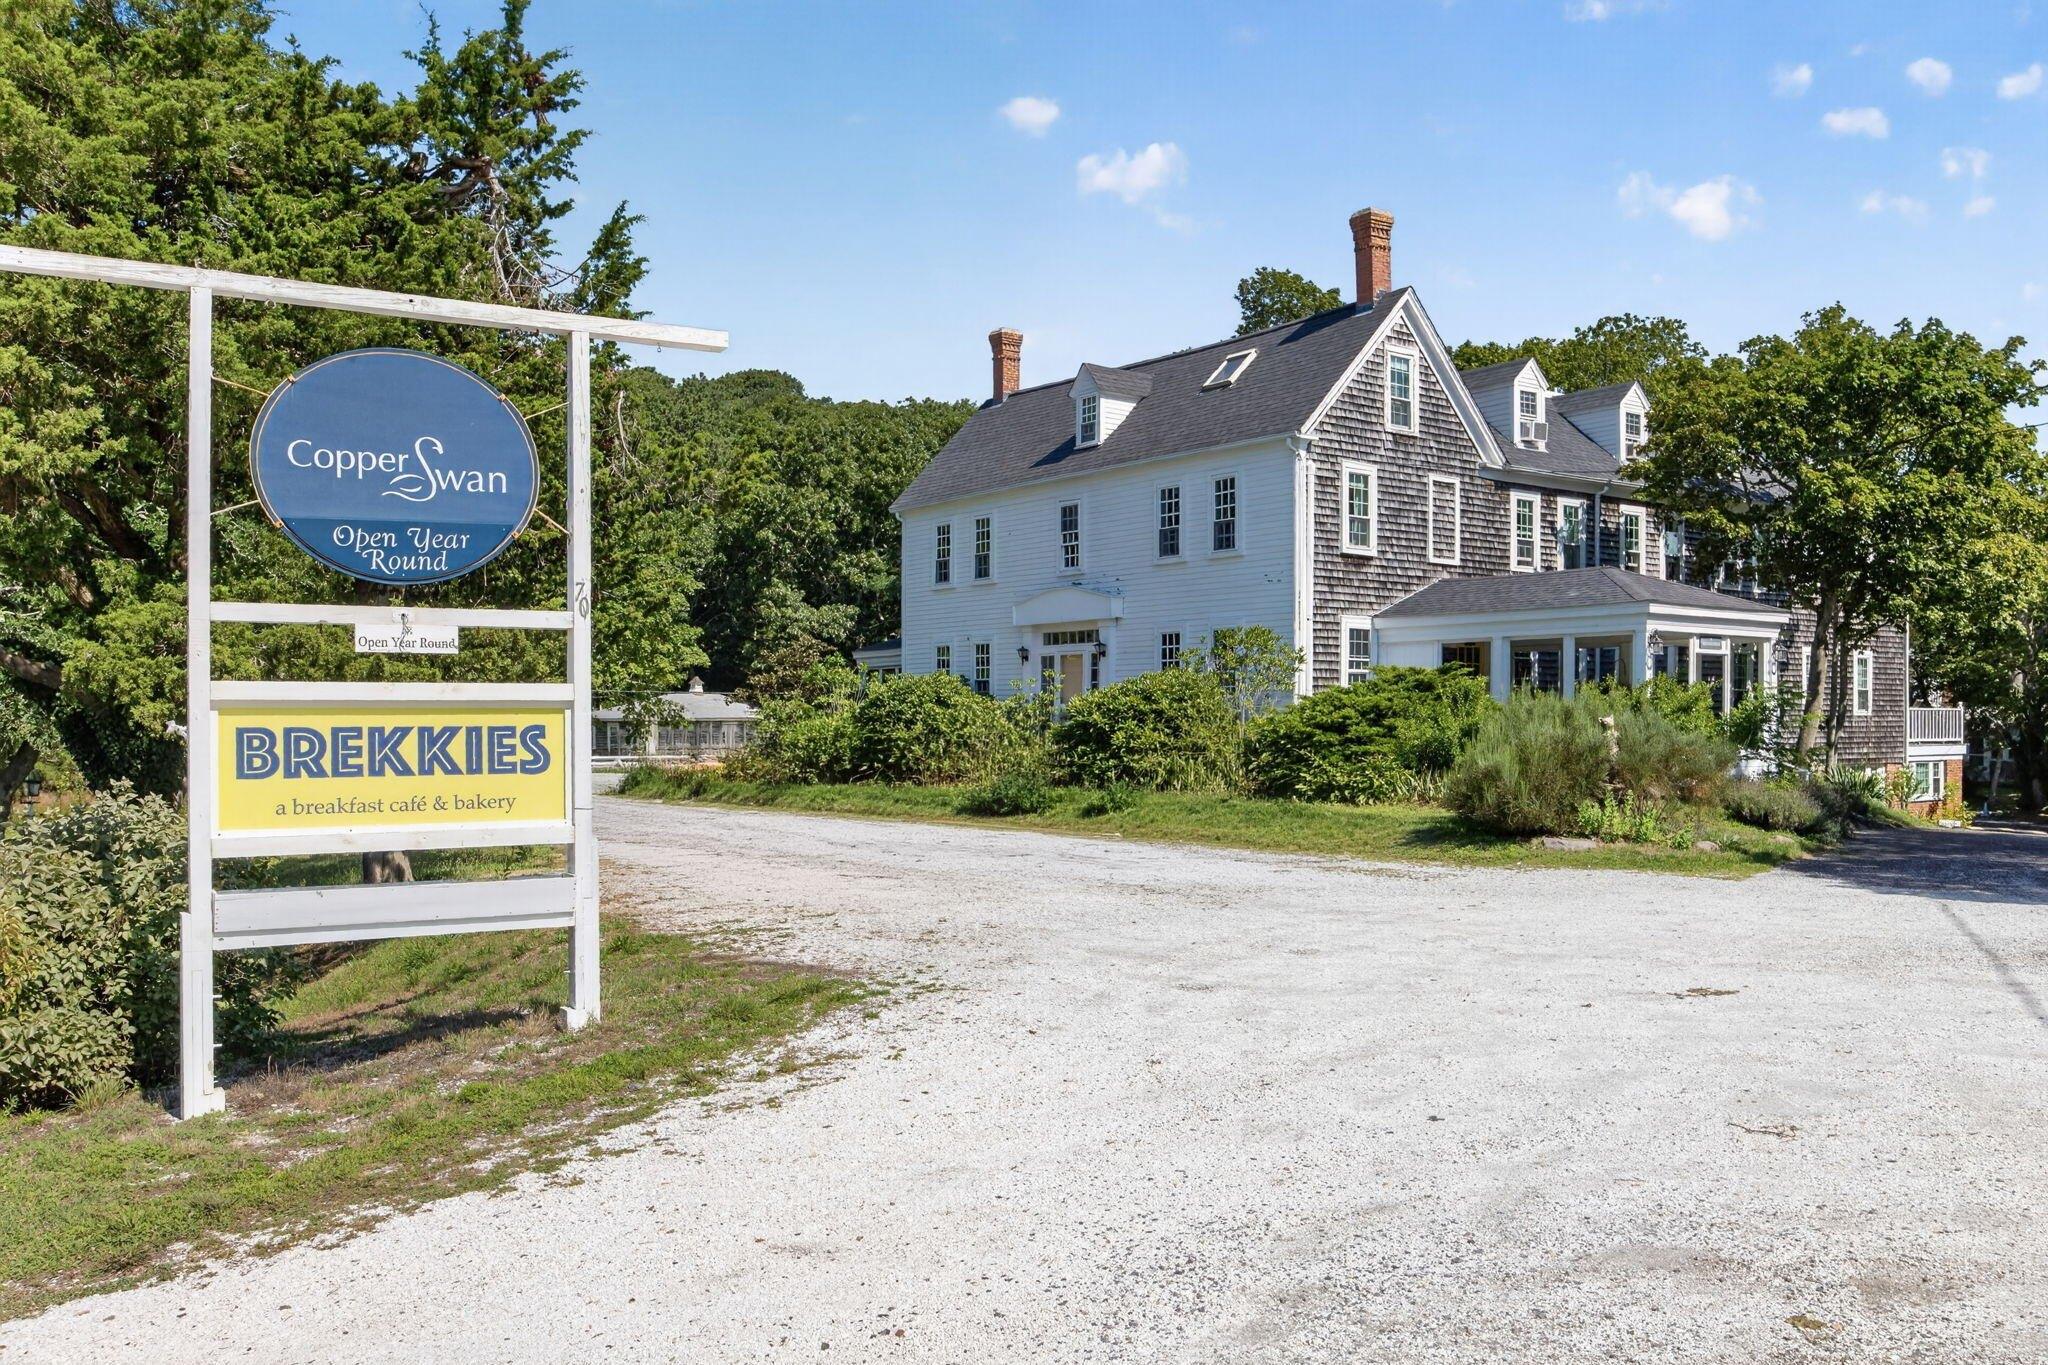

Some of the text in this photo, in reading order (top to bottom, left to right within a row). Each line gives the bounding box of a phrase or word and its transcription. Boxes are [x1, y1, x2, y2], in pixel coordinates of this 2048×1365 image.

[287, 437, 508, 502] Copper Swan
[333, 525, 470, 553] Open Year
[362, 549, 448, 575] Round
[358, 636, 456, 650] Open Year Round
[235, 724, 551, 780] BREKKIES
[275, 795, 517, 816] a breakfast café & bakery
